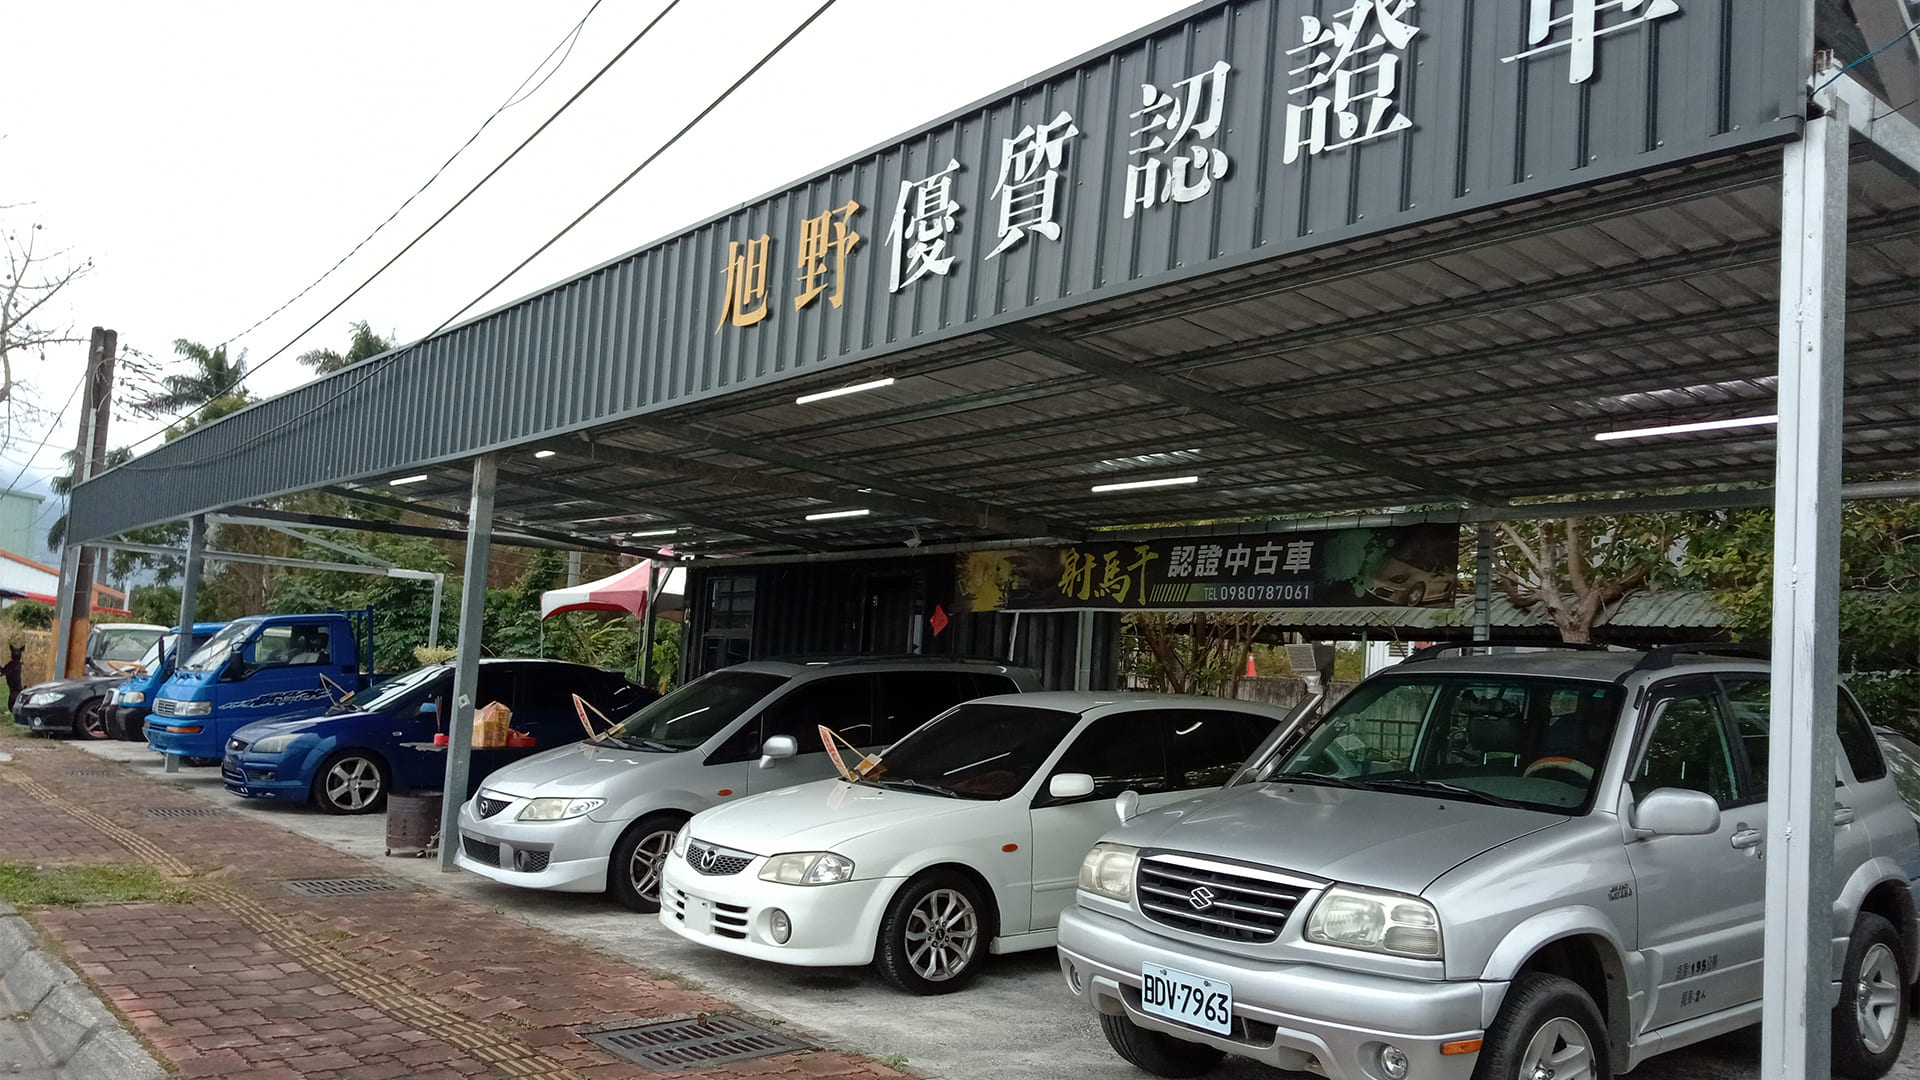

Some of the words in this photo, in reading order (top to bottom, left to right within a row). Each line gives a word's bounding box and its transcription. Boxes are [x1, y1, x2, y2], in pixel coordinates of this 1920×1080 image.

[1167, 539, 1315, 578] 認證中古車
[1203, 587, 1218, 601] TEL
[1220, 584, 1310, 601] 0980787061
